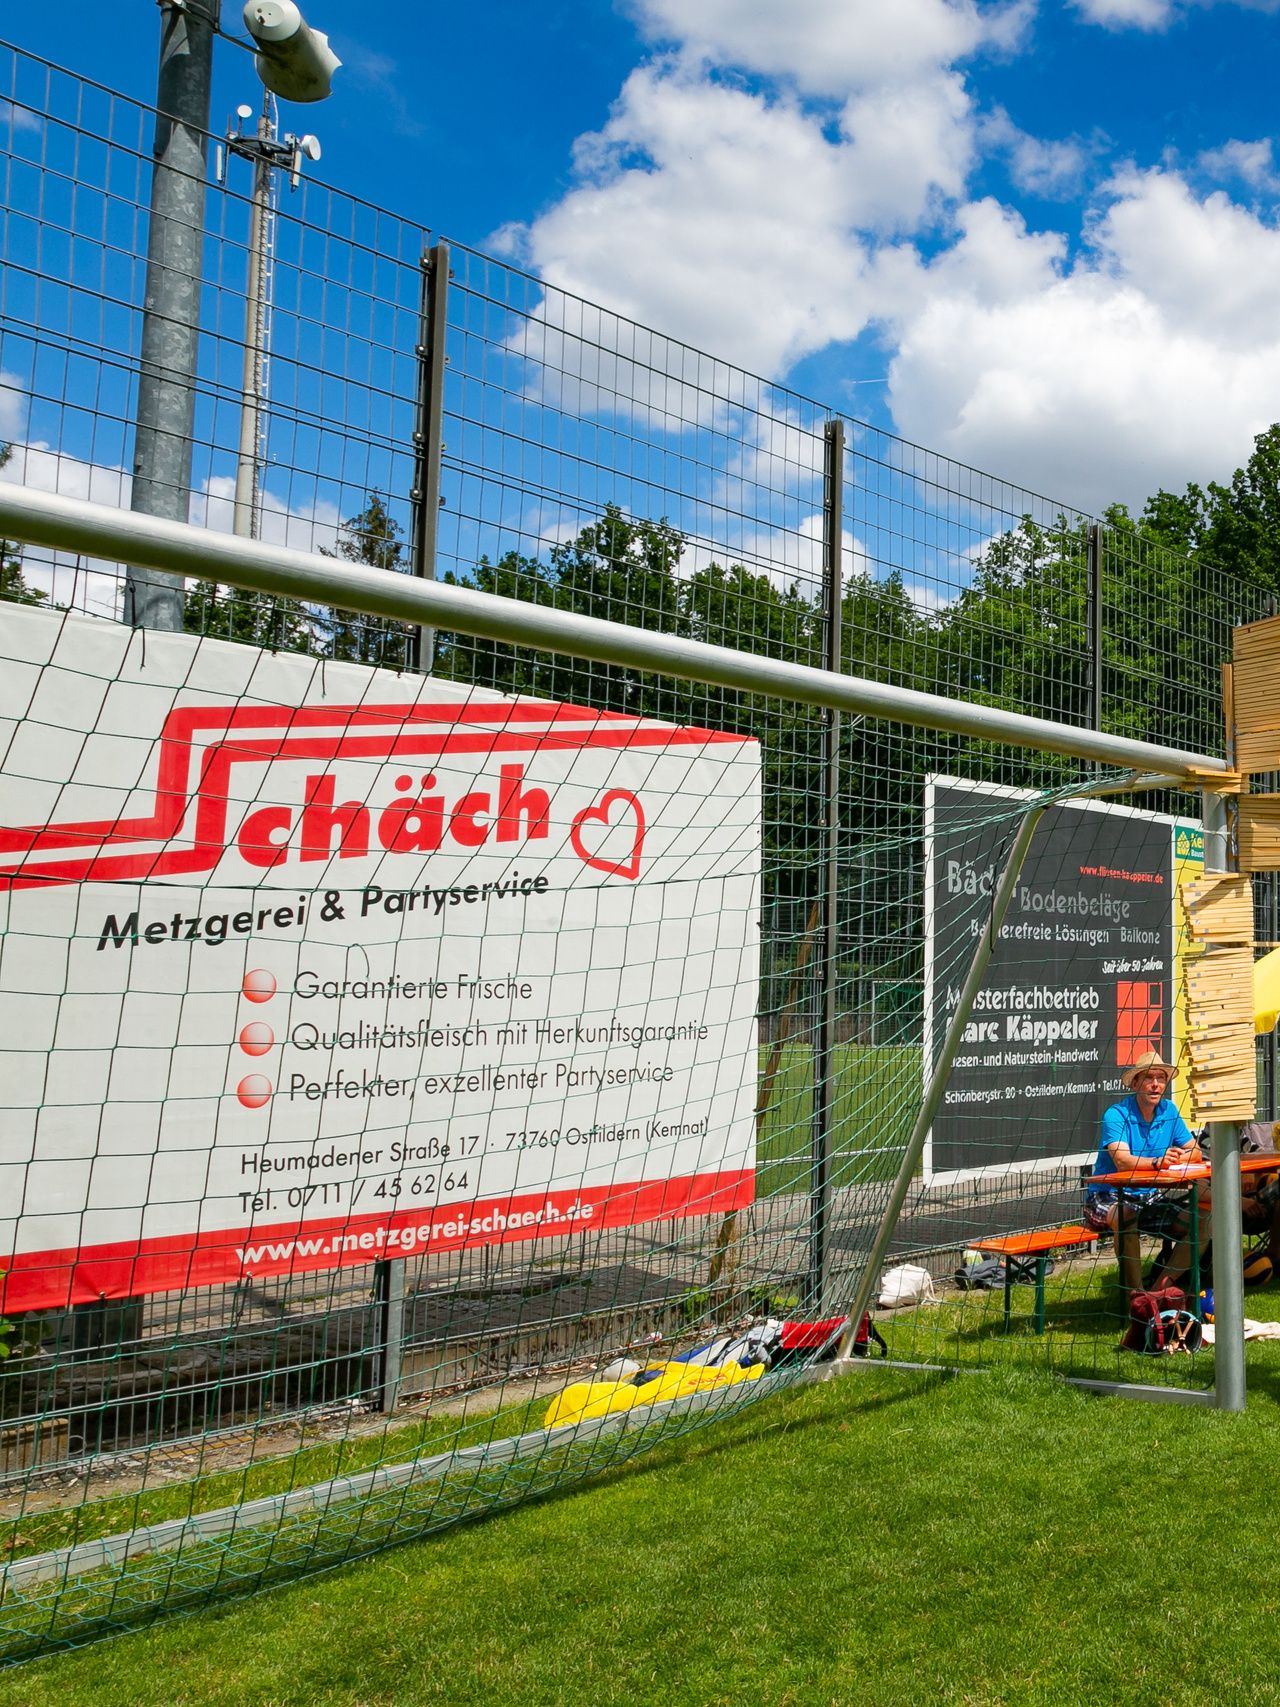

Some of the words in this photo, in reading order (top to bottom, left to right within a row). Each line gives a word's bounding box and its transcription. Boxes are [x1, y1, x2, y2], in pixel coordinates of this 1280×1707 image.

[96, 895, 307, 952] Metzgerei
[320, 889, 346, 922] &
[360, 870, 549, 917] Partyservice
[1020, 887, 1131, 923] Bodenbeläge
[970, 919, 1051, 940] Baerefreie
[1055, 923, 1110, 947] Lösungen
[293, 970, 449, 999] Garantierte
[457, 973, 533, 999] Frische
[945, 984, 1100, 1010] Msterfachbetrieb
[291, 1019, 488, 1050] Qualitätsfleisch
[496, 1022, 528, 1045] mit
[535, 1017, 709, 1048] Herkunftsgarantie
[1006, 1013, 1099, 1046] Käppeler
[289, 1068, 416, 1101] Perfekter,
[424, 1064, 549, 1094] exzellenter
[555, 1061, 674, 1093] Partyservice
[241, 1145, 383, 1175] Heumadener
[390, 1137, 451, 1163] Straße
[459, 1135, 480, 1156] 17
[505, 1129, 561, 1150] 73760
[565, 1122, 640, 1146] Ostfildern
[645, 1115, 709, 1143] (Kemnat)
[238, 1188, 278, 1213] Tel.
[287, 1182, 341, 1207] 0711
[373, 1177, 402, 1198] 45
[410, 1174, 435, 1195] 62
[443, 1170, 469, 1192] 64
[235, 1197, 594, 1266] www.metzgerei-schaech.de
